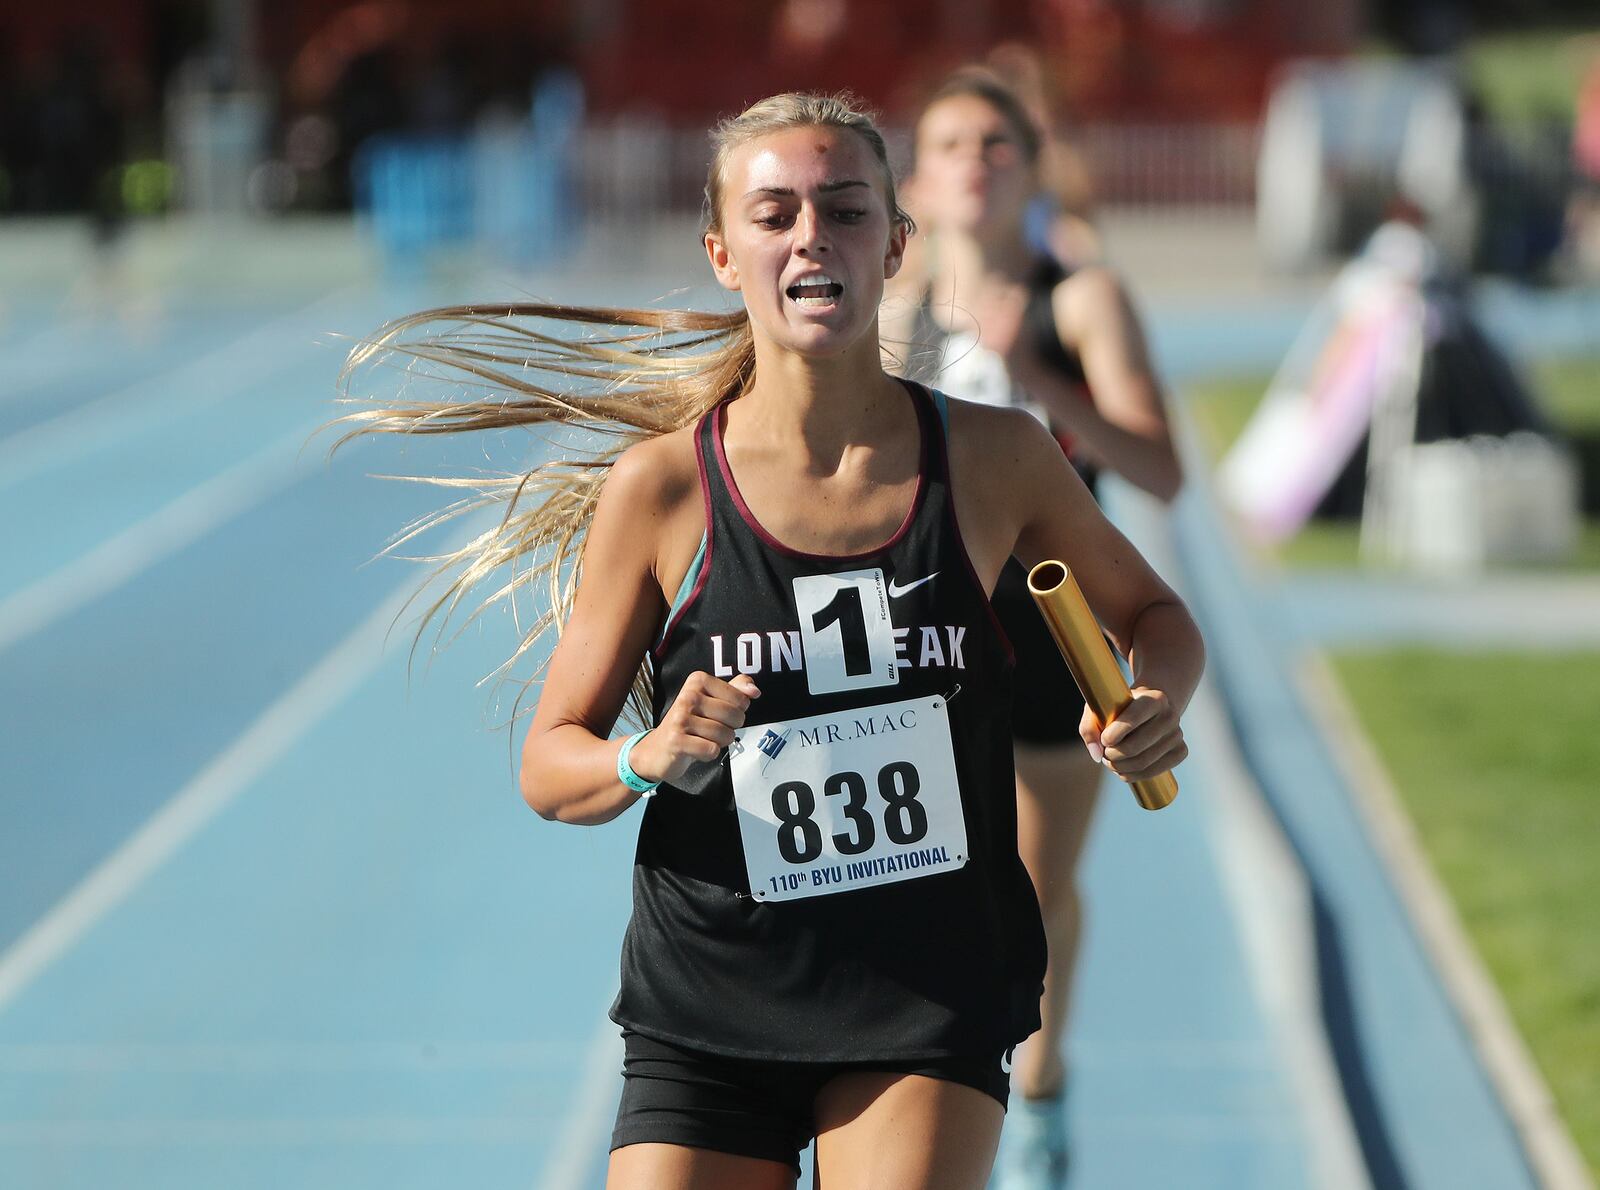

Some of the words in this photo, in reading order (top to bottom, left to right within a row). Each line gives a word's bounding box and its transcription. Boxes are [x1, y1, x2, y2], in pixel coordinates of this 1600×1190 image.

[711, 630, 803, 677] LON
[892, 626, 966, 669] EAK
[812, 586, 872, 677] 1
[771, 760, 928, 864] 838
[770, 871, 807, 893] 110th
[811, 864, 842, 887] BYU
[846, 846, 950, 881] INVITATIONAL
